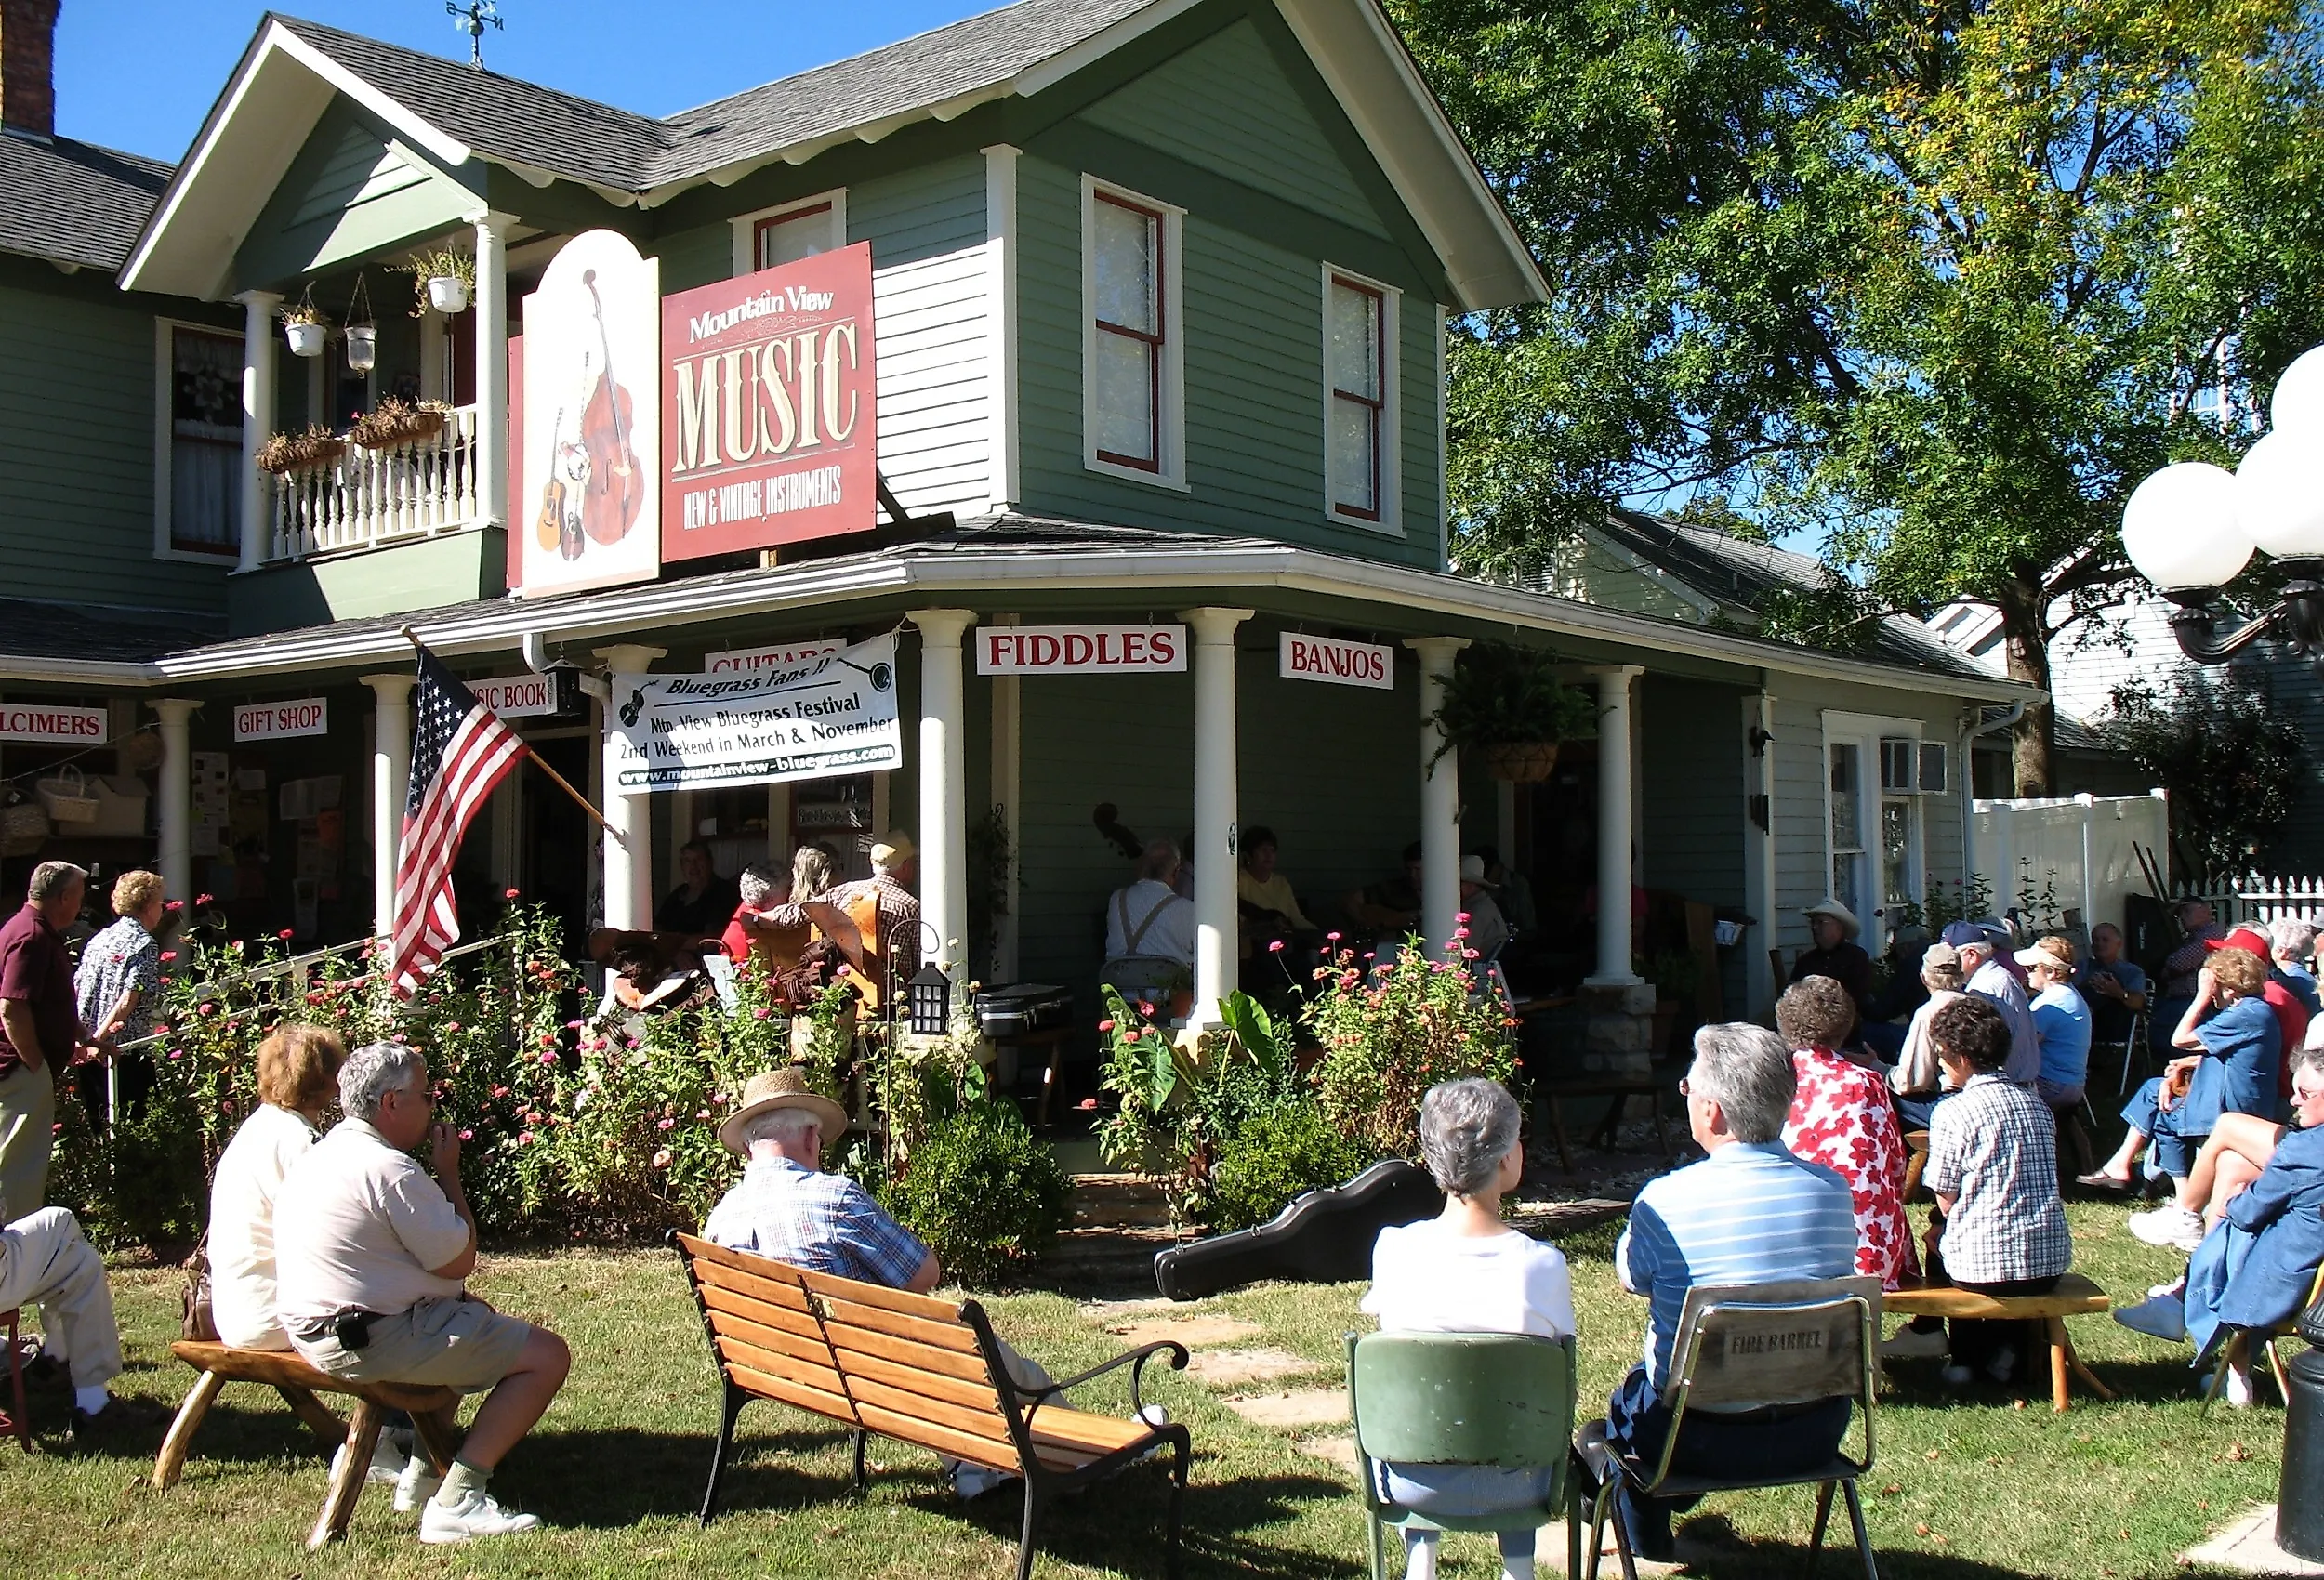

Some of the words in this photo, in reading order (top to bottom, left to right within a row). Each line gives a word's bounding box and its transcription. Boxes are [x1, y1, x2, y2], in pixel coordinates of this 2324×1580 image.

[690, 290, 785, 344] Mountain
[785, 285, 834, 312] View
[671, 323, 857, 473] MUSIC
[683, 490, 706, 530] NEW
[708, 488, 719, 526] &
[720, 479, 763, 523] VINTAGE
[765, 465, 841, 515] INSTRUMENTS
[988, 632, 1175, 666] FIDDLES
[1291, 640, 1384, 681] BANJOS
[472, 686, 500, 709] SIC
[666, 677, 762, 698] Bluegrass
[766, 667, 809, 688] Fans
[0, 712, 99, 736] LCIMERS
[239, 710, 273, 733] GIFT
[278, 705, 322, 731] SHOP
[650, 718, 676, 734] Mtn.
[679, 713, 714, 731] View
[716, 705, 791, 729] Bluegrass
[794, 691, 861, 718] Festival
[620, 743, 648, 759] 2nd
[654, 737, 714, 758] Weekend
[719, 736, 732, 752] in
[737, 730, 786, 750] March
[791, 727, 806, 744] &
[812, 716, 894, 742] November
[619, 745, 895, 784] www.mountainview-bluegrass.com
